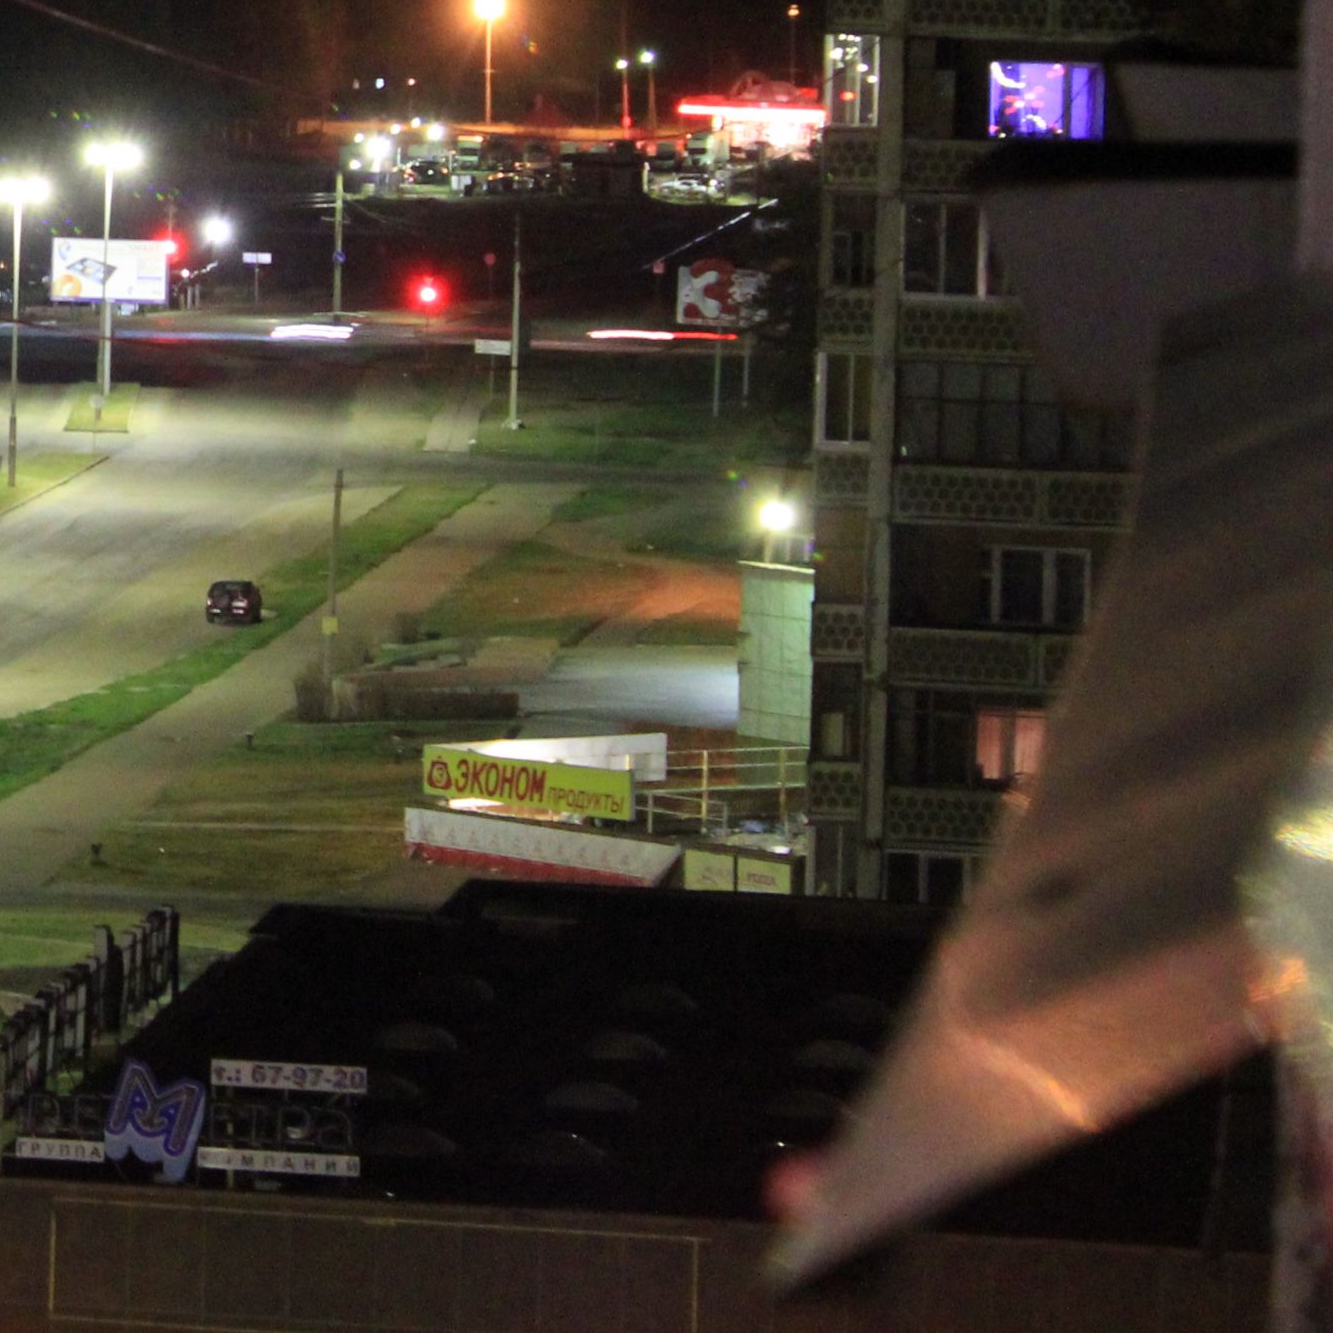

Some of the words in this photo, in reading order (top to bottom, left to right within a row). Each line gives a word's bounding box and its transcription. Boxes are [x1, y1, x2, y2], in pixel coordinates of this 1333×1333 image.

[455, 759, 547, 802] ЭКОНОМ
[548, 787, 624, 813] ПРОДУКТЫ
[251, 1063, 365, 1090] 67-97-20
[18, 1140, 102, 1159] ГРУППА
